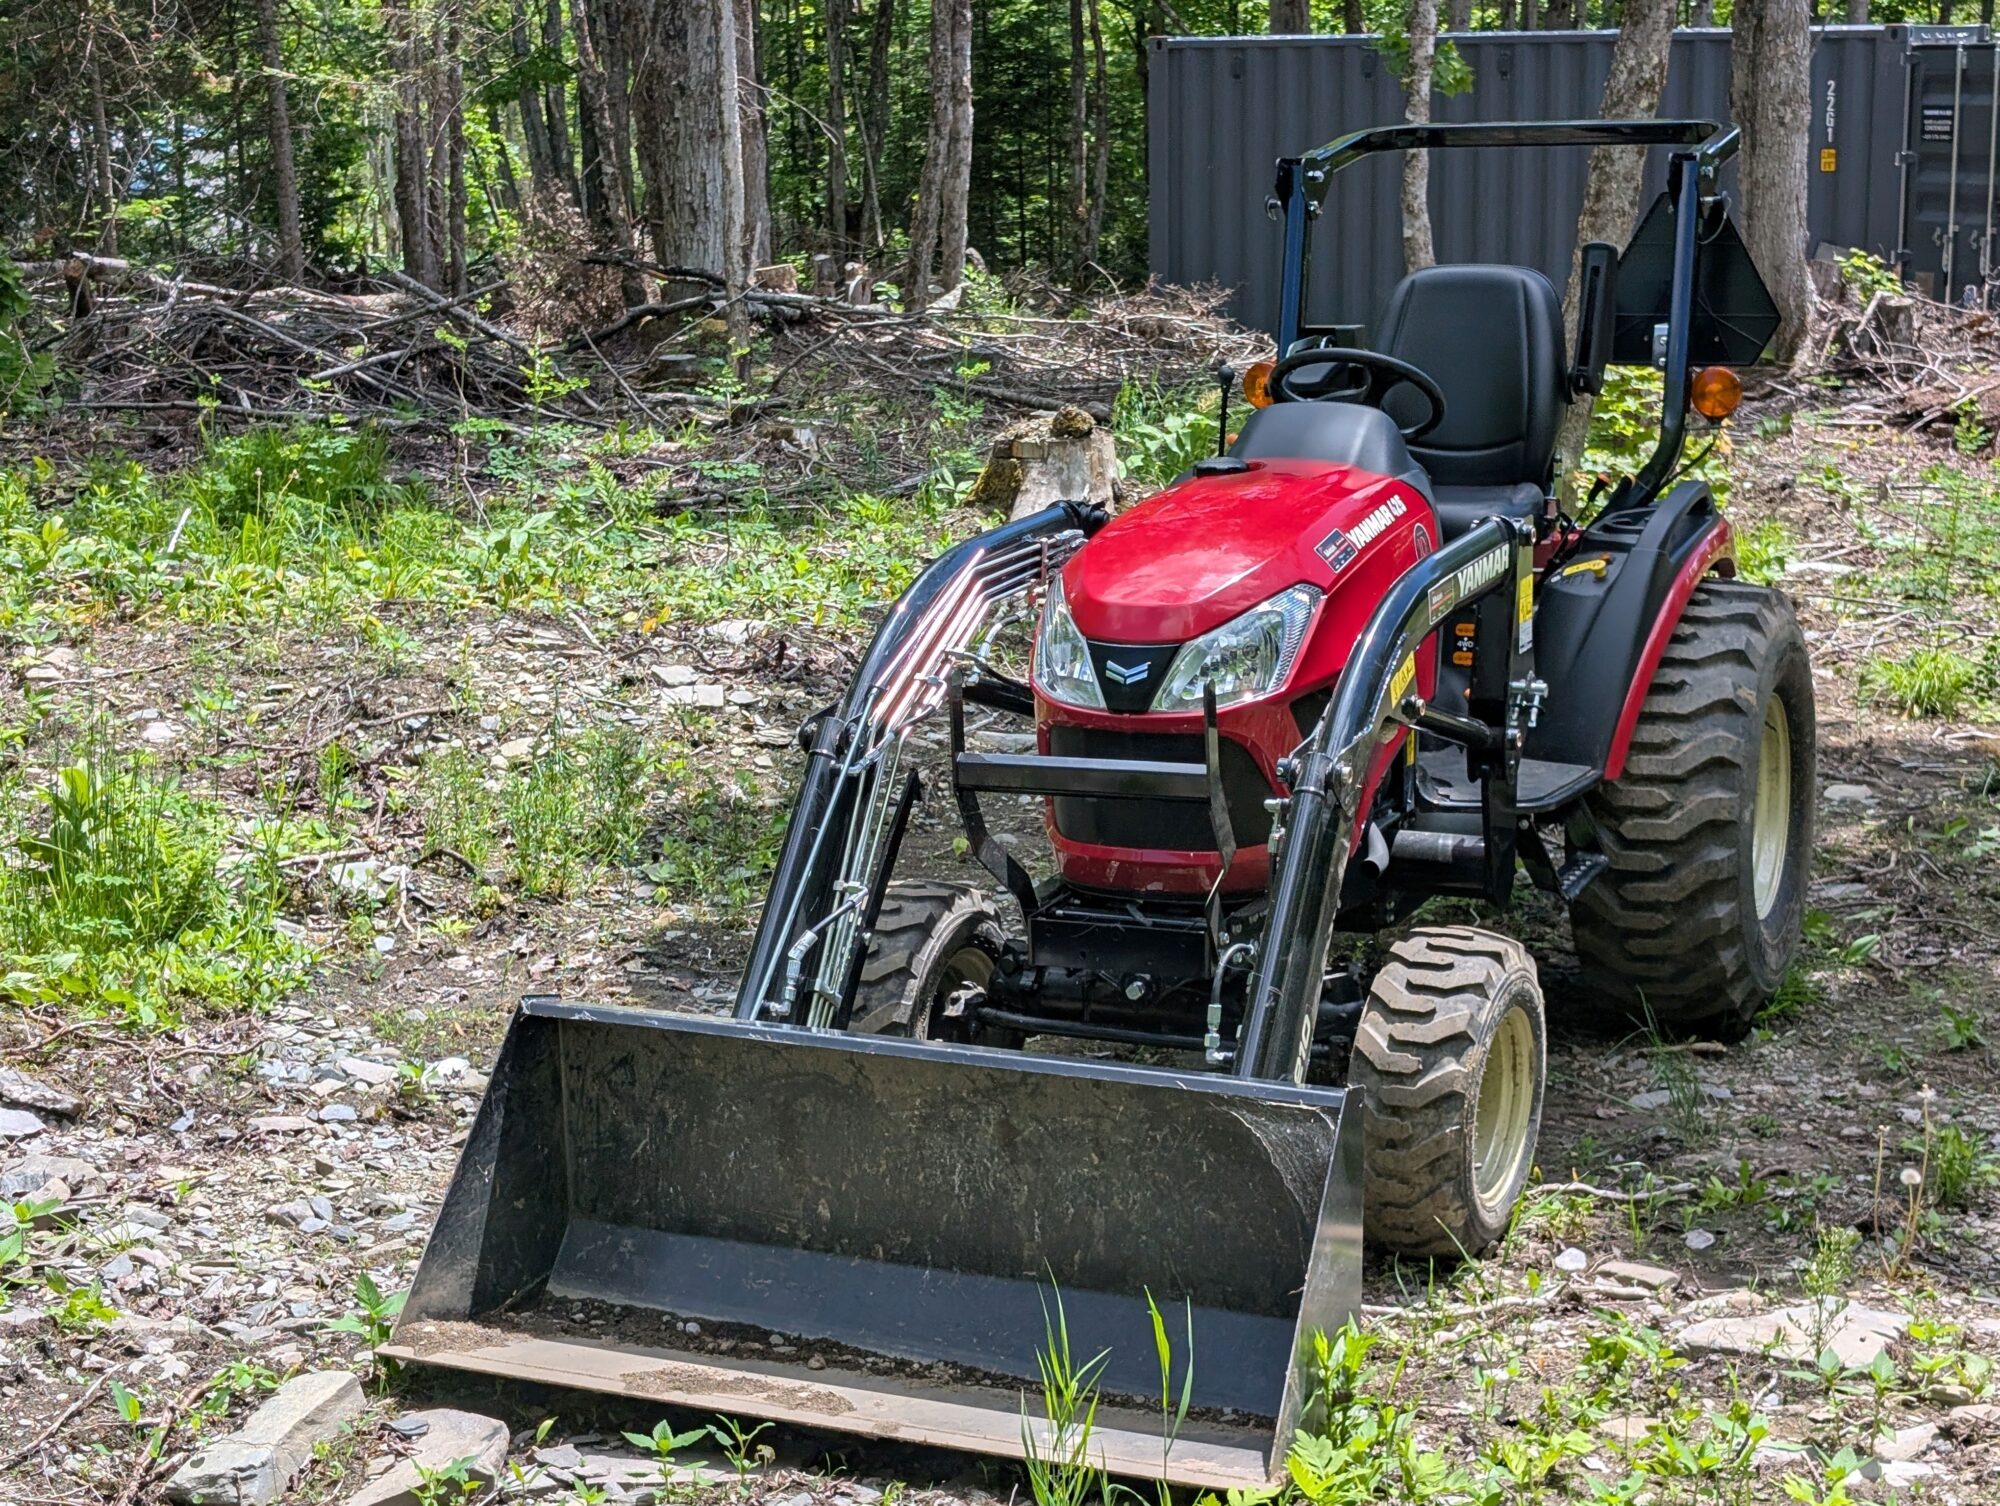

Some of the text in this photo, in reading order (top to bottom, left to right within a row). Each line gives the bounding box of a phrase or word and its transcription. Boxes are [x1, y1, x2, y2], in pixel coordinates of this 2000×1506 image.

[1826, 80, 1836, 143] 22G1
[1345, 504, 1396, 549] YANMAR
[1457, 544, 1510, 597] YANMAR
[1457, 640, 1474, 648] 4WD
